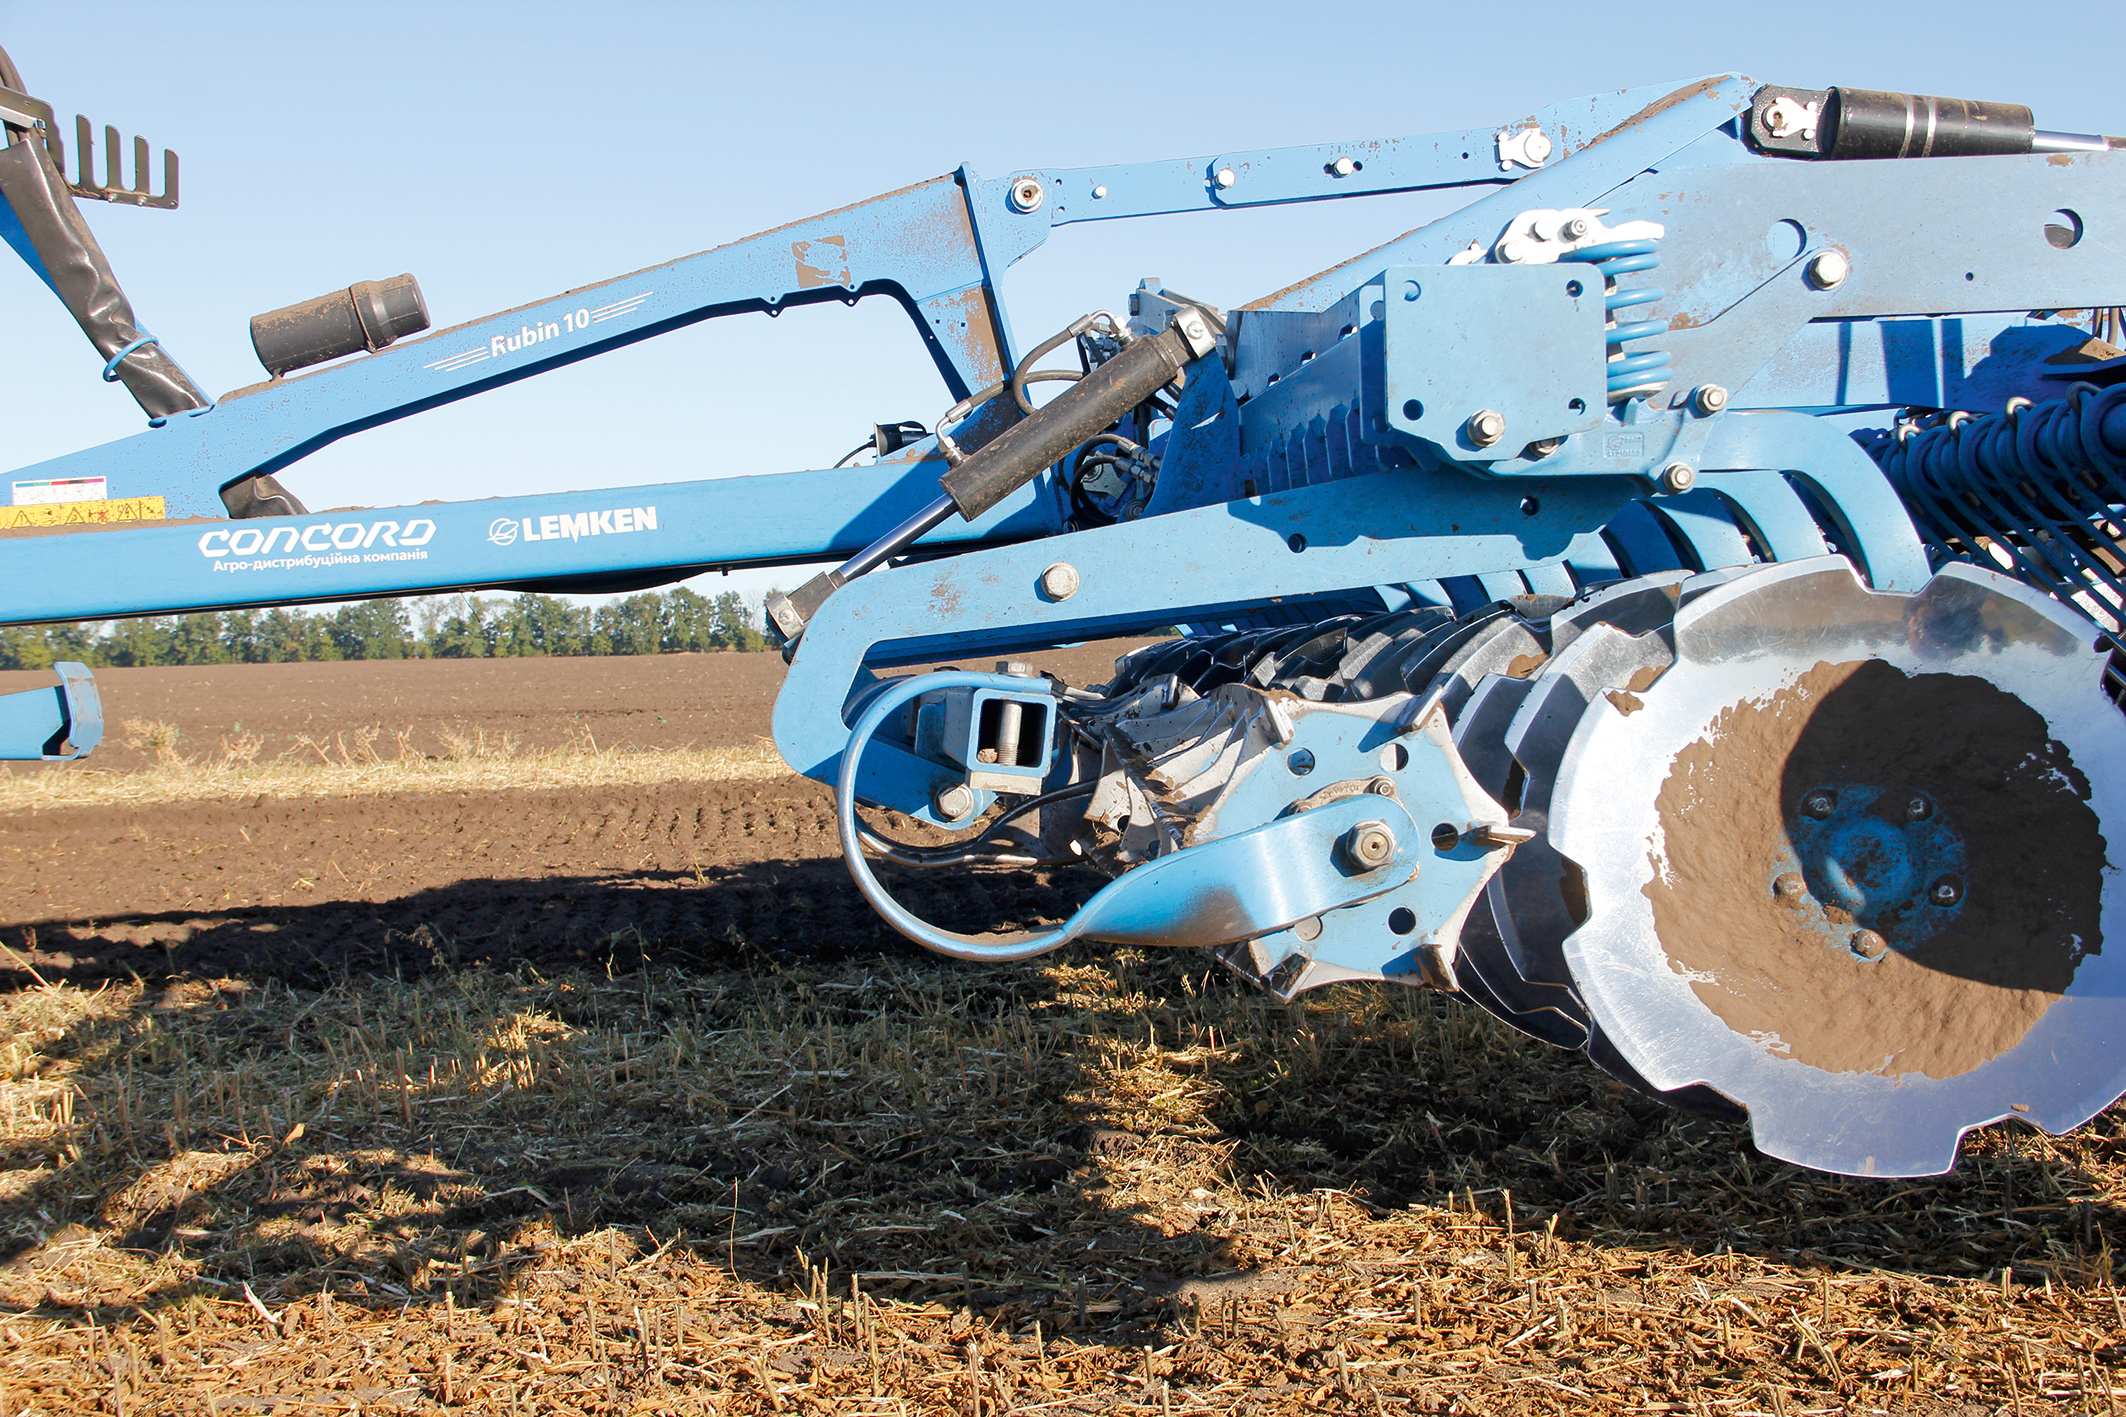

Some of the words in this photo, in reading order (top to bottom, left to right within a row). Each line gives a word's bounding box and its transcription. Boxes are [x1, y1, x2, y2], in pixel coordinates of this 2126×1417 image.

[491, 321, 560, 357] Rubin
[563, 308, 590, 333] 10
[198, 519, 437, 558] CONCORD
[522, 506, 658, 543] LEMKEN
[213, 553, 360, 573] Агро-дистрибуційна
[363, 548, 428, 563] компанія
